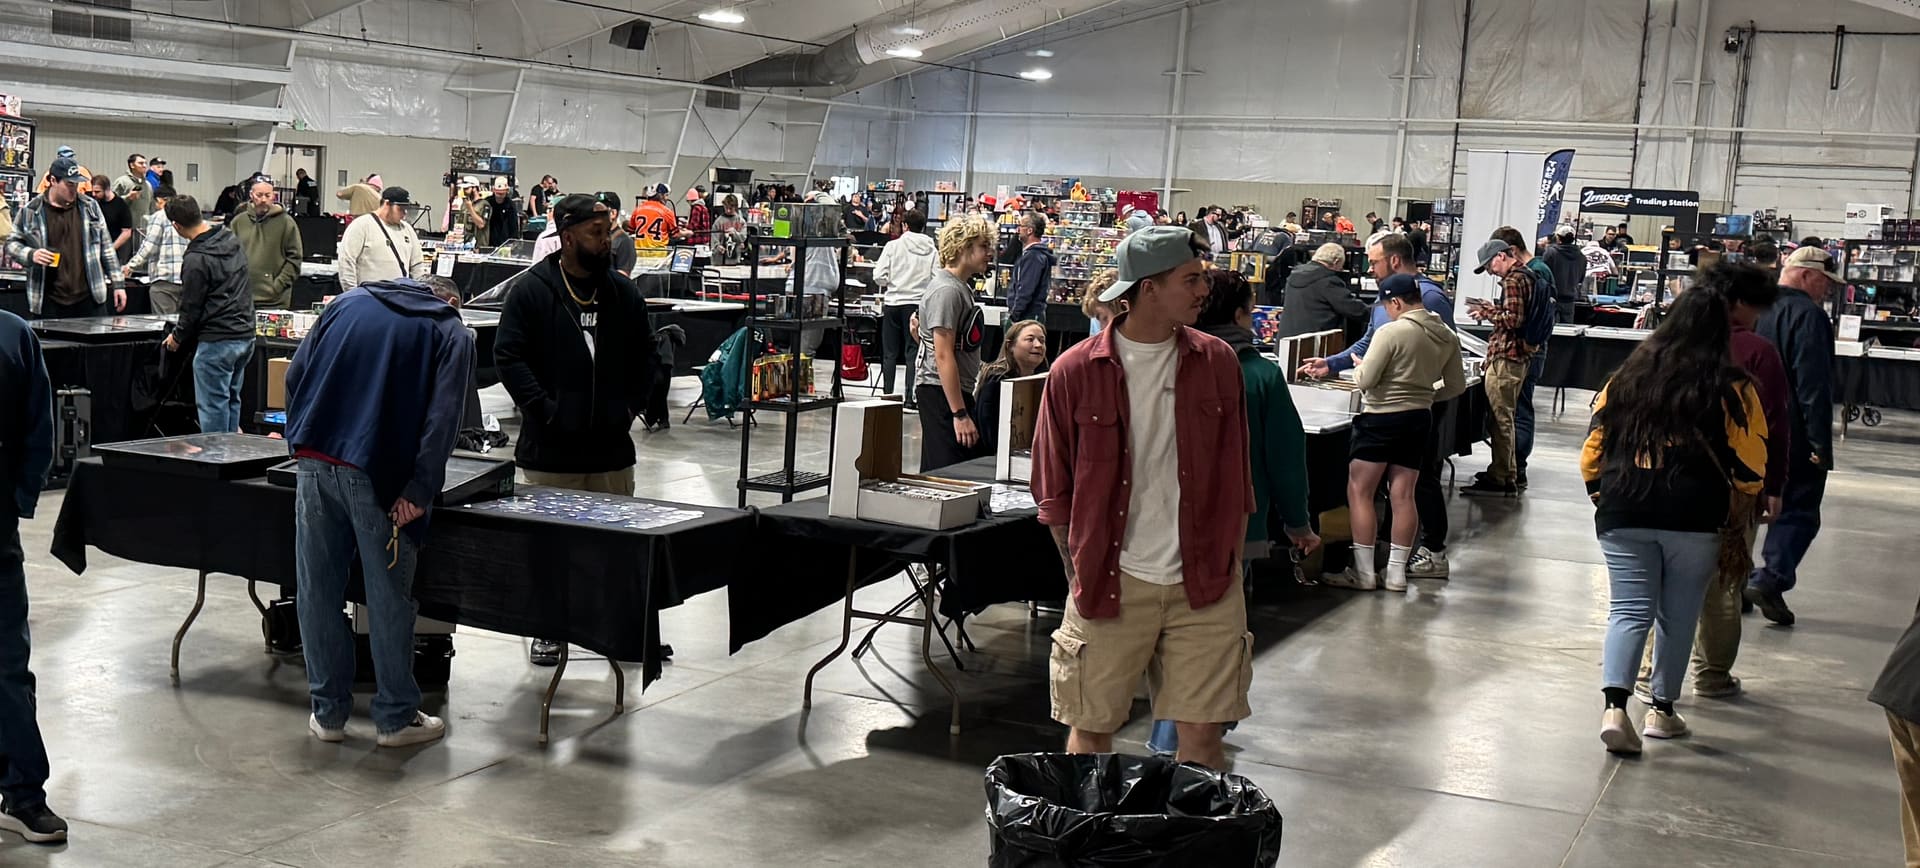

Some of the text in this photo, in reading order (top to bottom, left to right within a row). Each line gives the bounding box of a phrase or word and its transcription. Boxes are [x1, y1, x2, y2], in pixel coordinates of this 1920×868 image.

[1582, 190, 1699, 208] Impact Trading Station
[635, 215, 664, 241] 24
